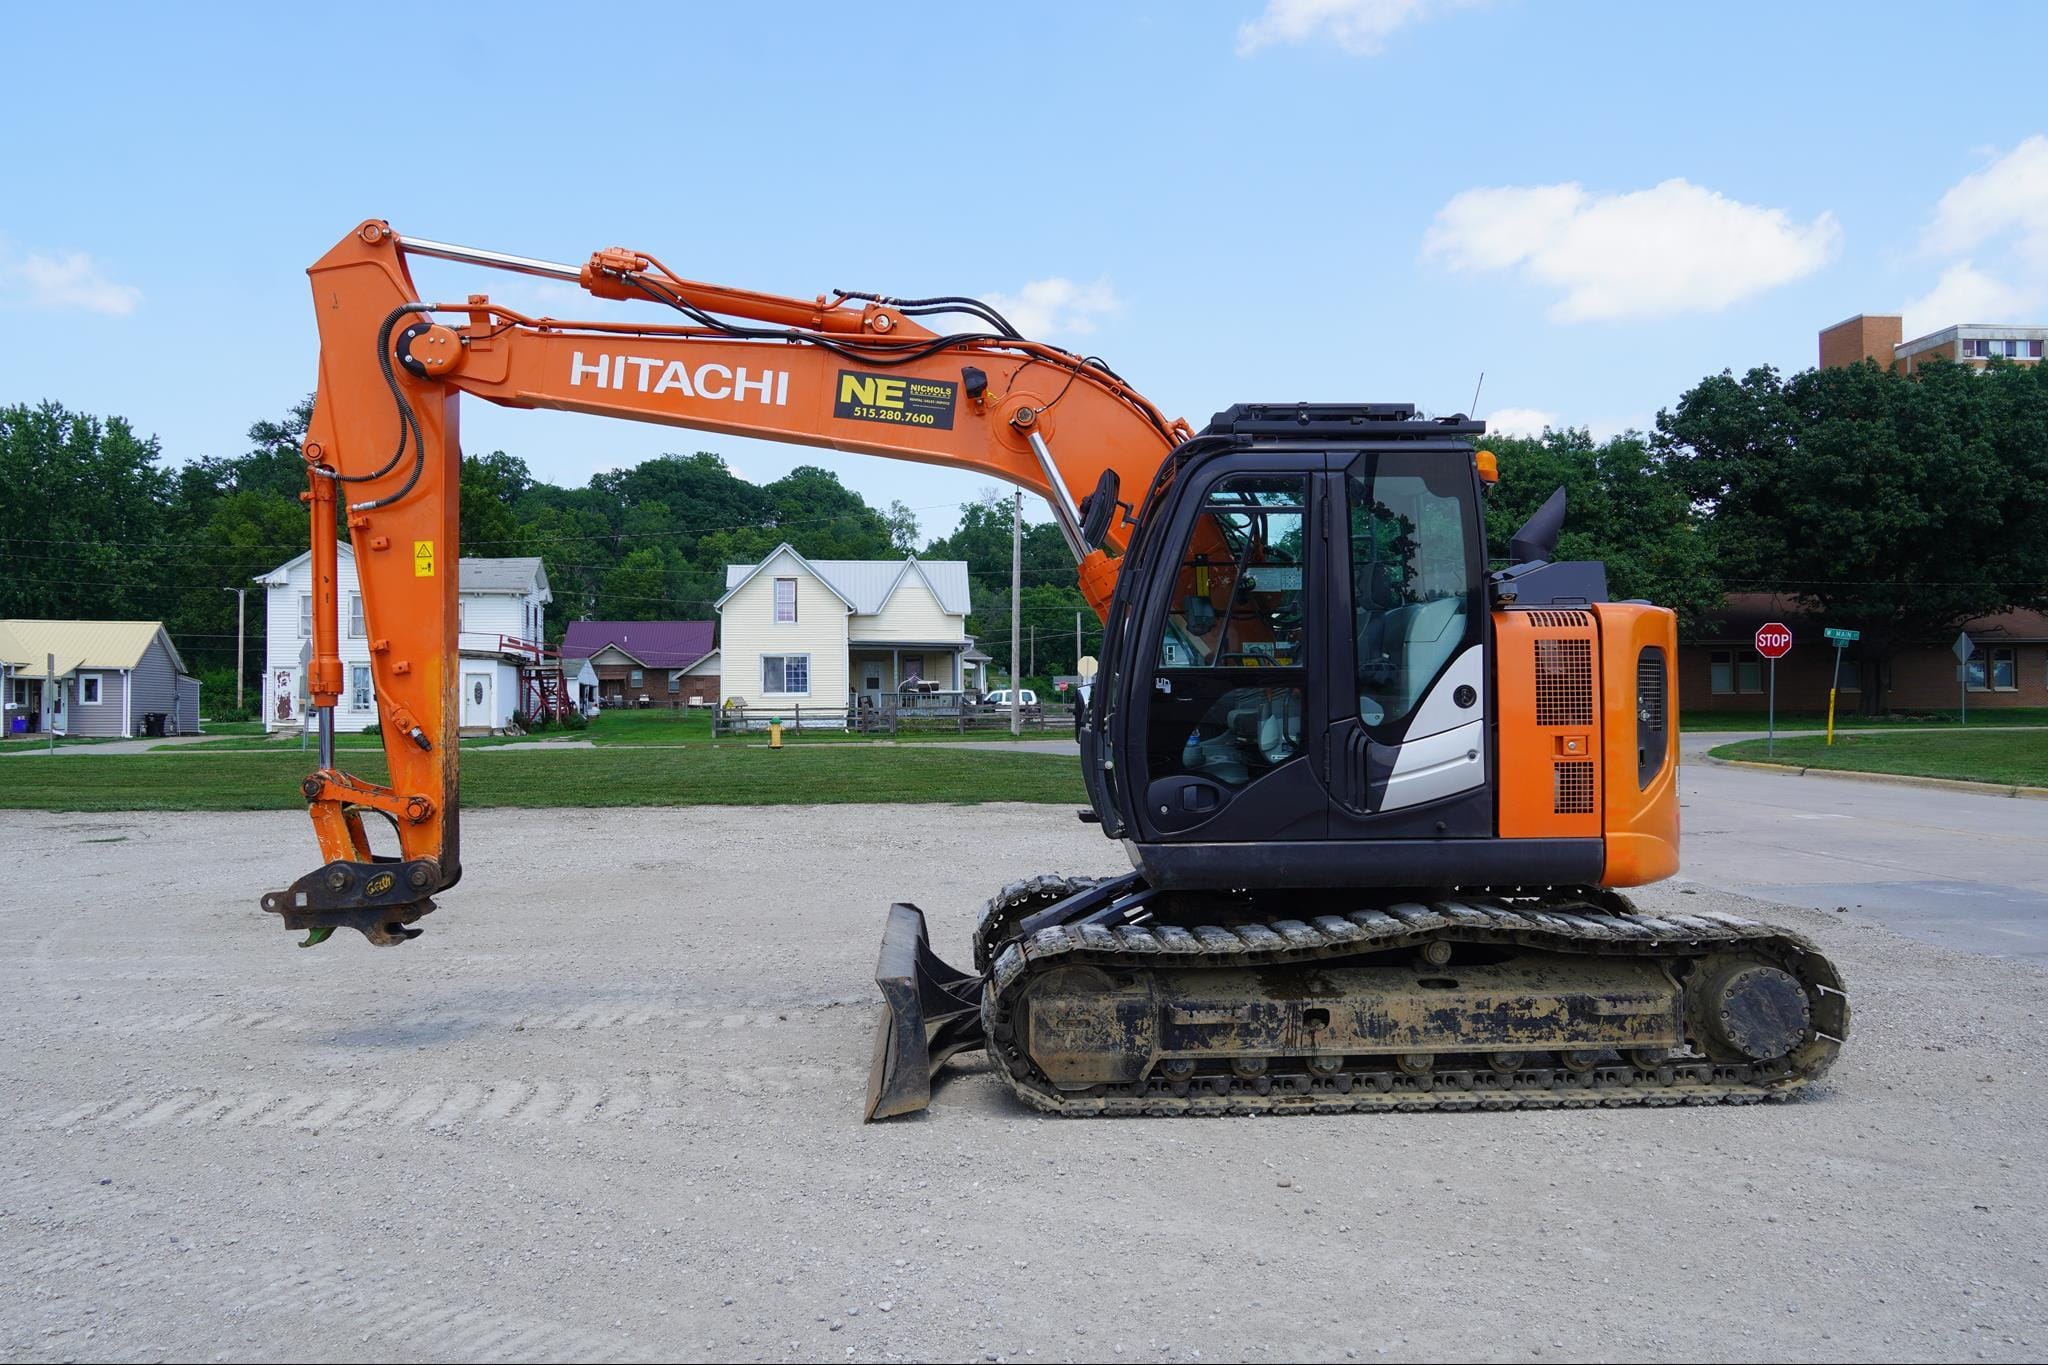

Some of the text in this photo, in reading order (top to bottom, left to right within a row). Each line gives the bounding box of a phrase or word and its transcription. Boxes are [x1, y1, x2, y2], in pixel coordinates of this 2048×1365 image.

[570, 351, 789, 406] HITACHI
[840, 375, 906, 409] NE
[911, 384, 952, 395] NICHOLS
[853, 407, 934, 424] 515.280.7600
[1758, 634, 1789, 647] STOP
[1836, 631, 1852, 639] MAIN
